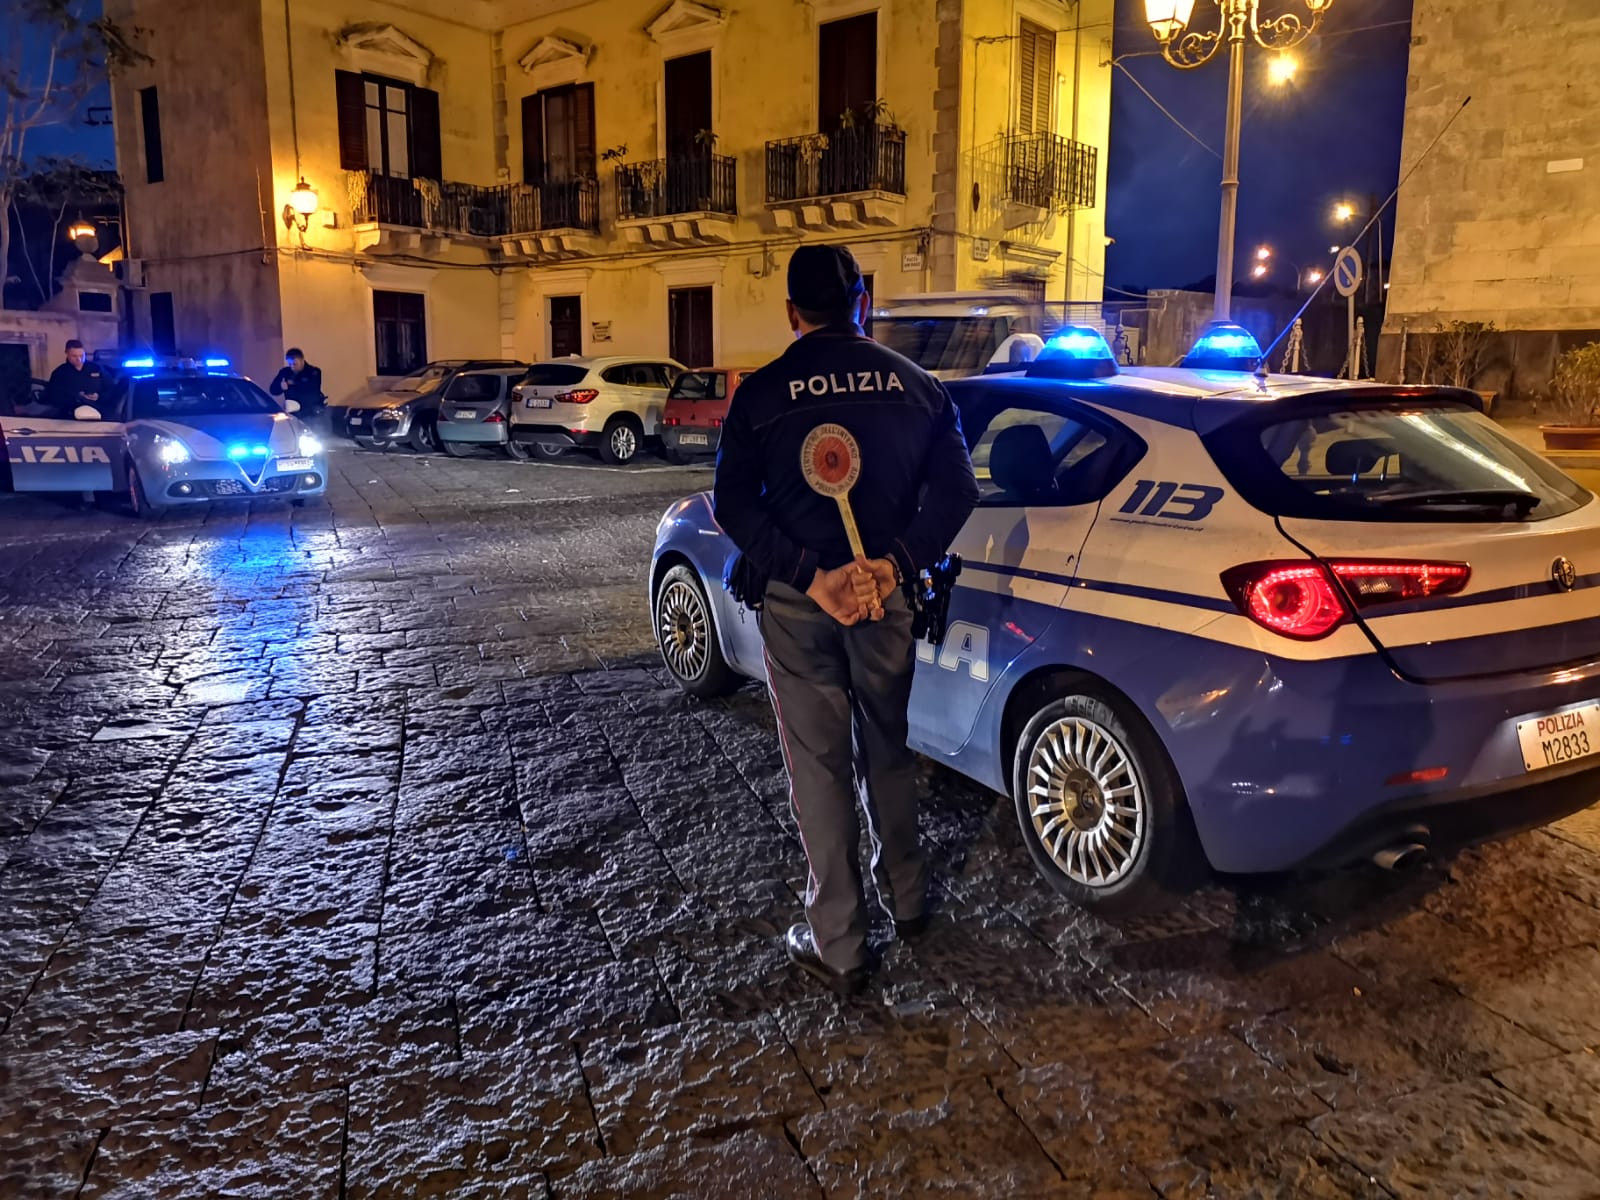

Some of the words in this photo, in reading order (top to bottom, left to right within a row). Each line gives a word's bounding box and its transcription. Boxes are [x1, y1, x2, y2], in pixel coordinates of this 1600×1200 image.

[788, 370, 905, 401] POLIZIA
[1118, 479, 1225, 522] 113
[1536, 711, 1585, 737] POLIZIA
[1542, 730, 1590, 766] M2833
